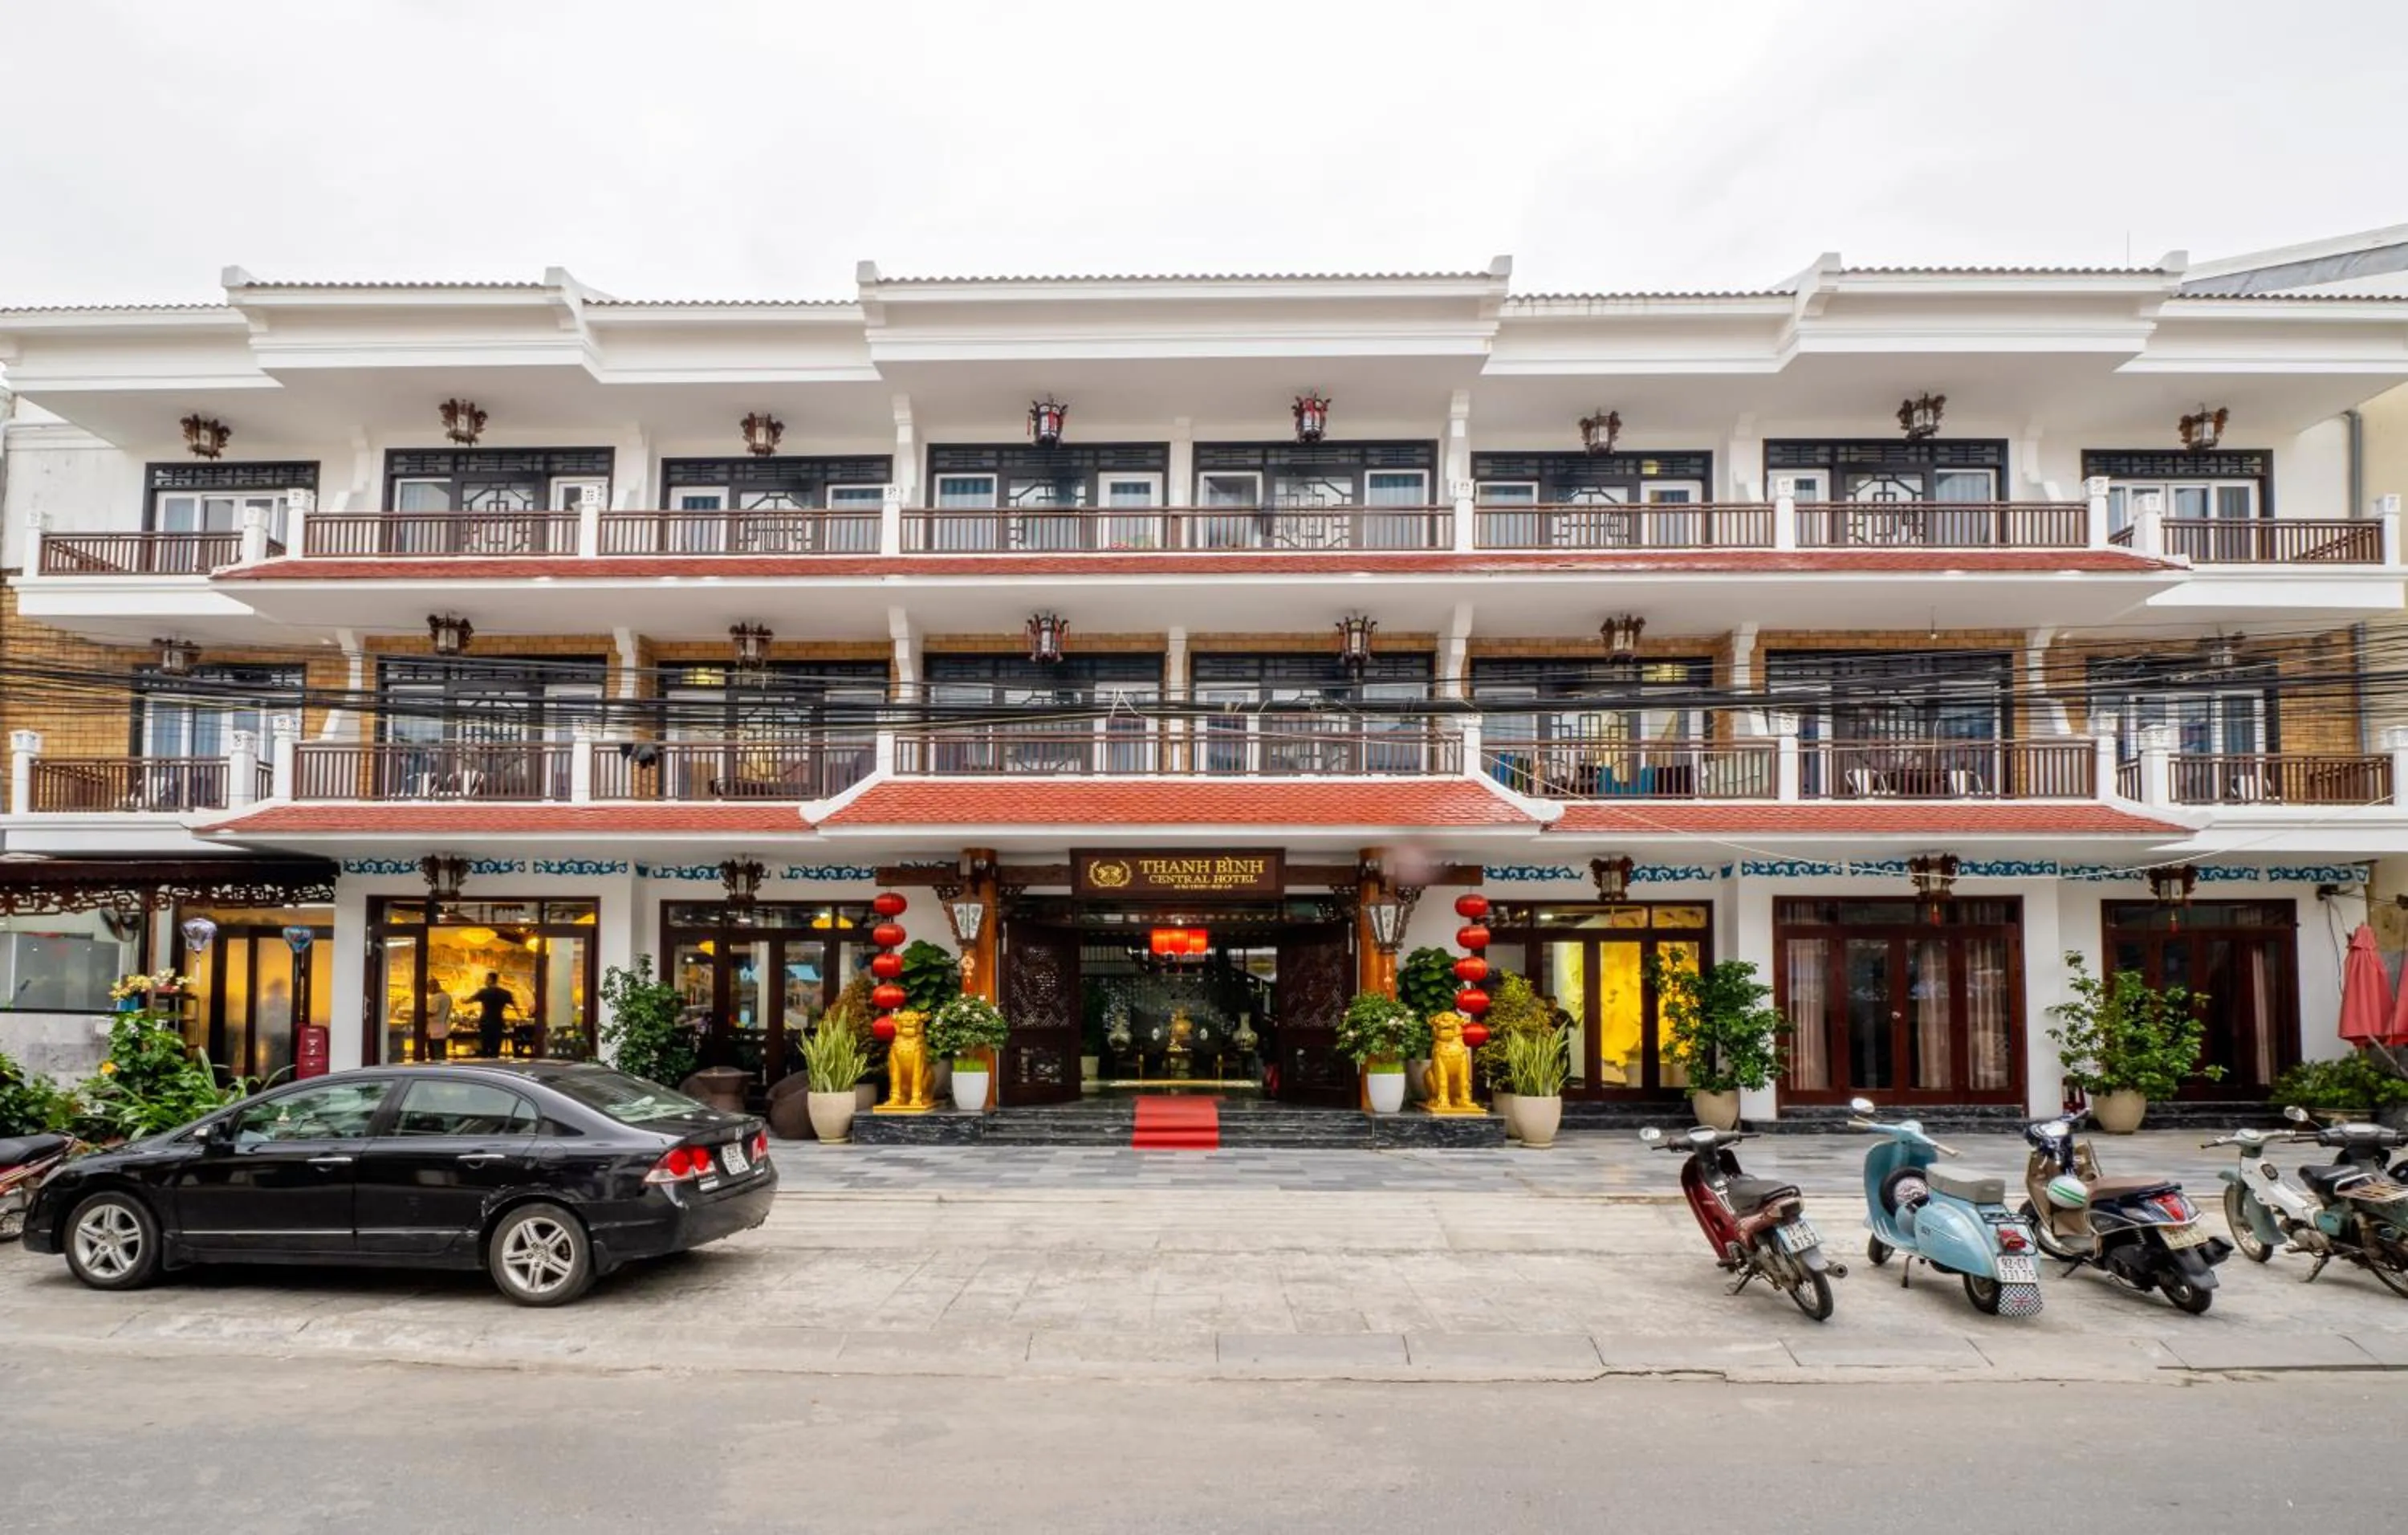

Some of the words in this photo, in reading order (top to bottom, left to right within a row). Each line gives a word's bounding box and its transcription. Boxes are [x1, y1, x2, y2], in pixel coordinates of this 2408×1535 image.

[1139, 860, 1210, 874] THANH
[1216, 857, 1264, 873] BÌNH
[1149, 874, 1210, 884] CENTRAL
[1214, 873, 1258, 883] HOTEL
